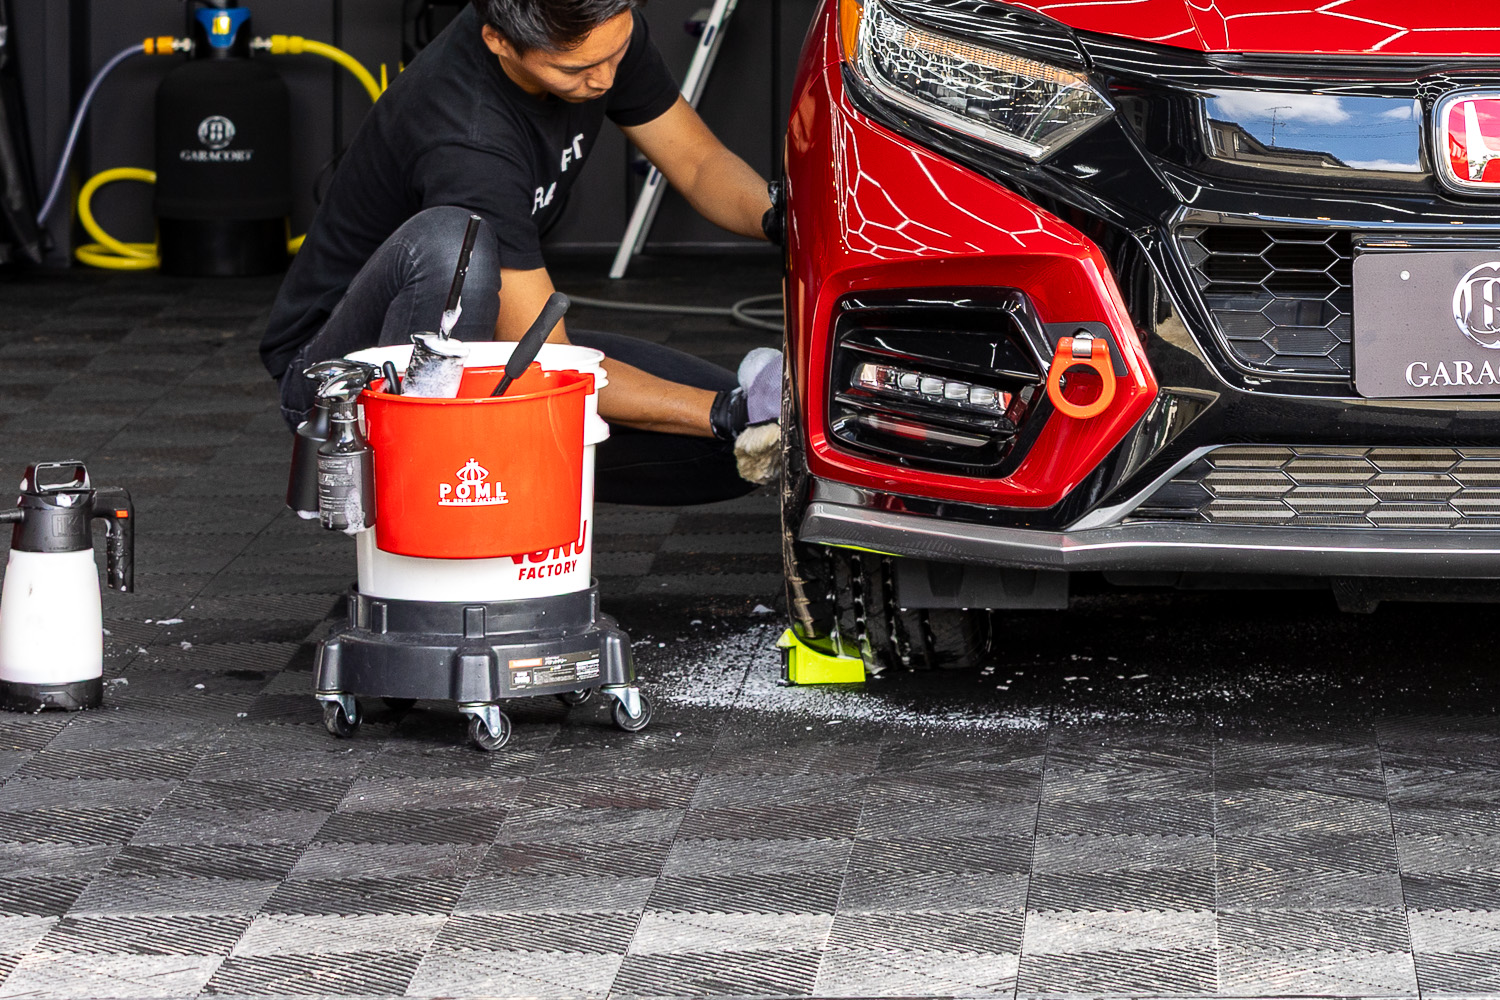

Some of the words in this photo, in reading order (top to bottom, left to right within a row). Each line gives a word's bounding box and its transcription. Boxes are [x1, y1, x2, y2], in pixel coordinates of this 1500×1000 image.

[180, 149, 254, 162] GARACORT
[439, 482, 507, 499] POML
[518, 559, 577, 580] FACTORY
